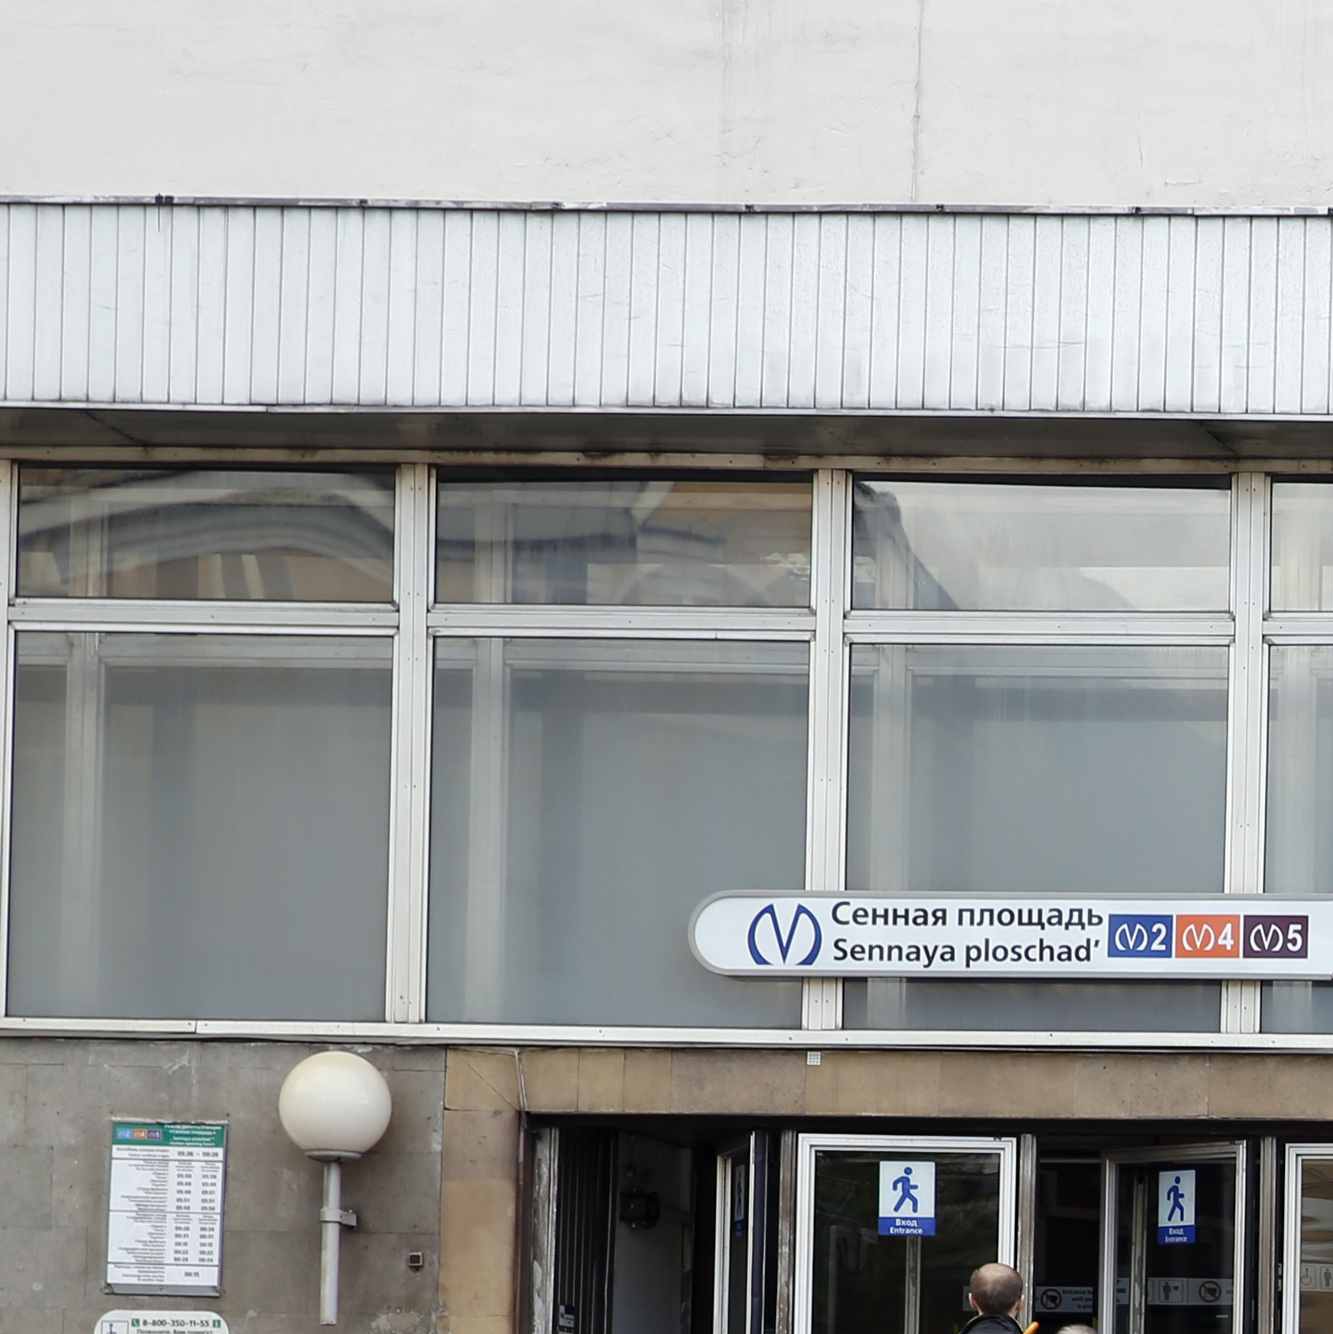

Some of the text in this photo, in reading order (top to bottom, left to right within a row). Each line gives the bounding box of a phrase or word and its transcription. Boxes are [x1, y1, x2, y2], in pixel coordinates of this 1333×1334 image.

[831, 900, 1104, 932] Сенная площадь
[833, 938, 956, 968] Sennaya
[890, 1227, 923, 1235] Entrance
[896, 1218, 918, 1227] Вход
